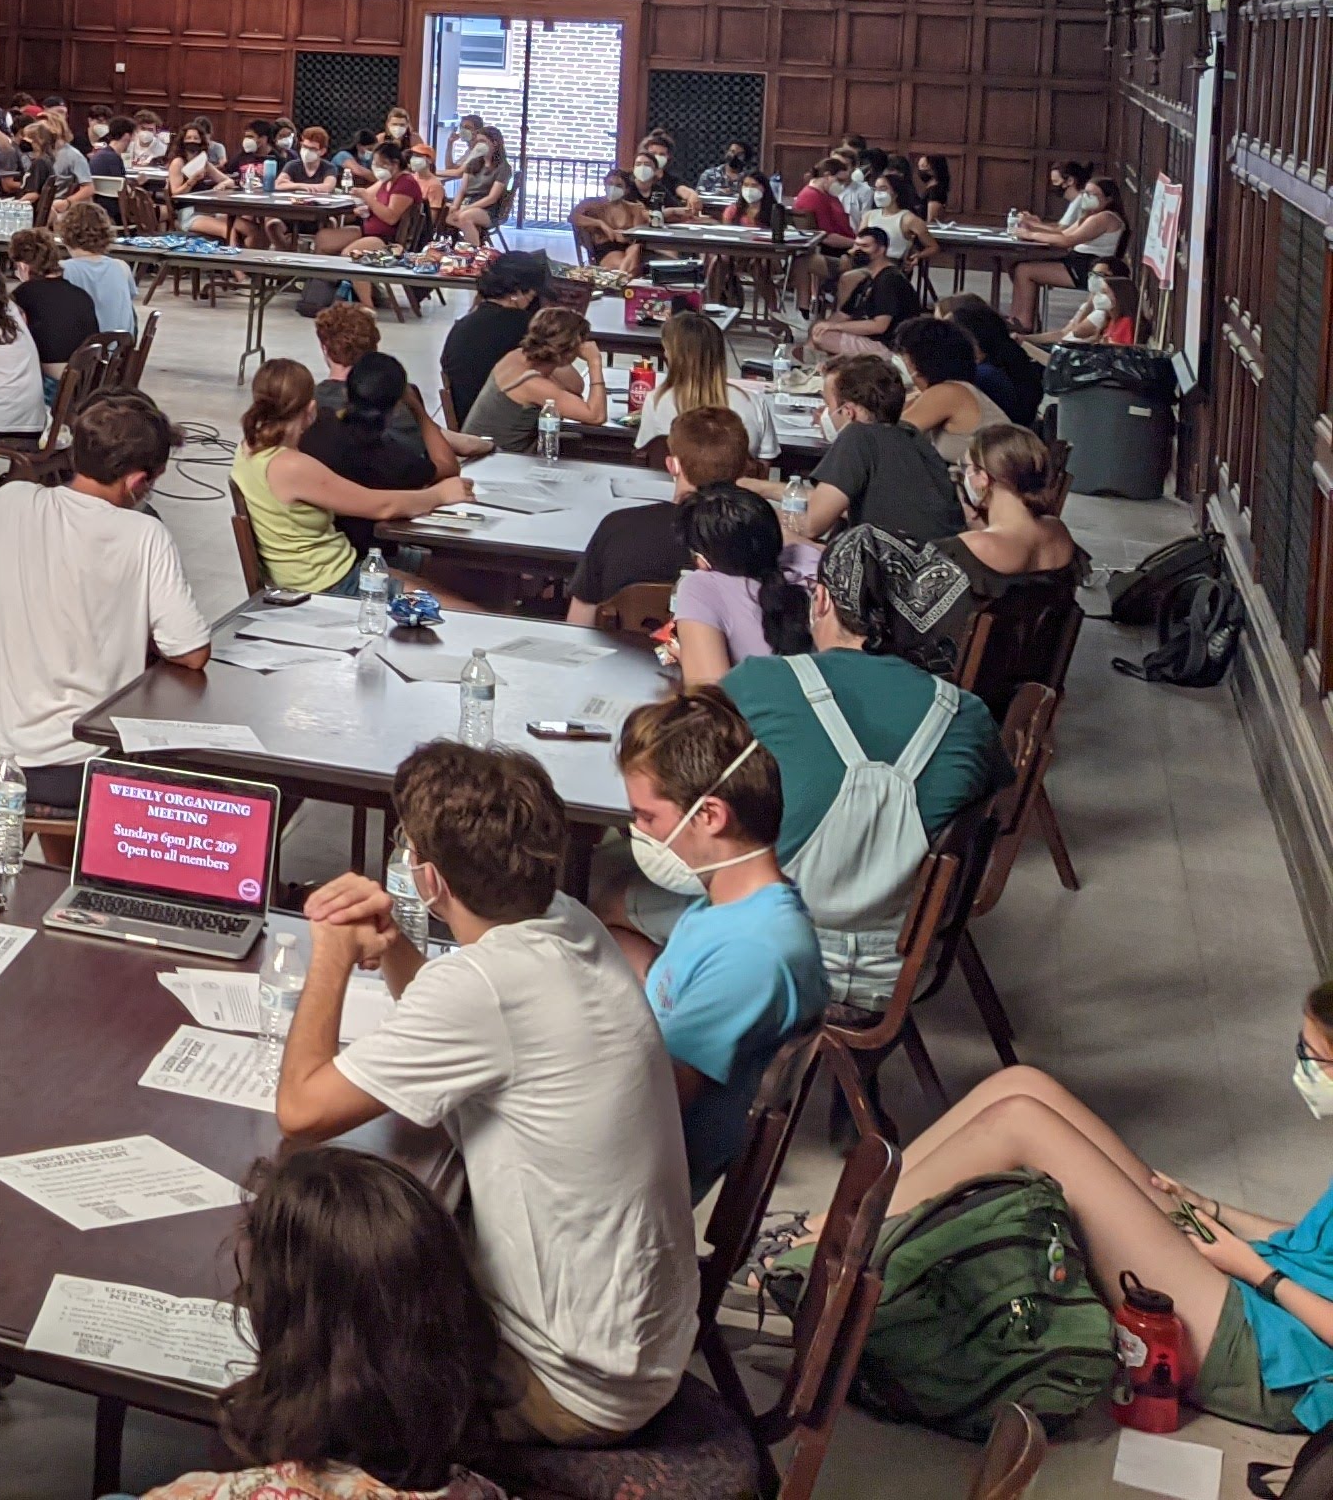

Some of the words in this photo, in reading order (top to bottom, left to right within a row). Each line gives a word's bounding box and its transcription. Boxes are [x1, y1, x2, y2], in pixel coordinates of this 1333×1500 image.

[109, 783, 163, 802] WEEKLY
[164, 793, 251, 816] ORGANIZING
[147, 805, 208, 825] MEETING
[114, 823, 158, 844] Sundays
[160, 831, 185, 847] 6pm
[186, 835, 214, 851] JRC
[214, 840, 237, 854] 209
[117, 841, 148, 858] Open
[150, 848, 162, 859] to
[164, 849, 177, 861] all
[179, 854, 230, 870] members
[104, 1286, 167, 1306] UGSDW
[109, 1293, 185, 1316] KICKOFF
